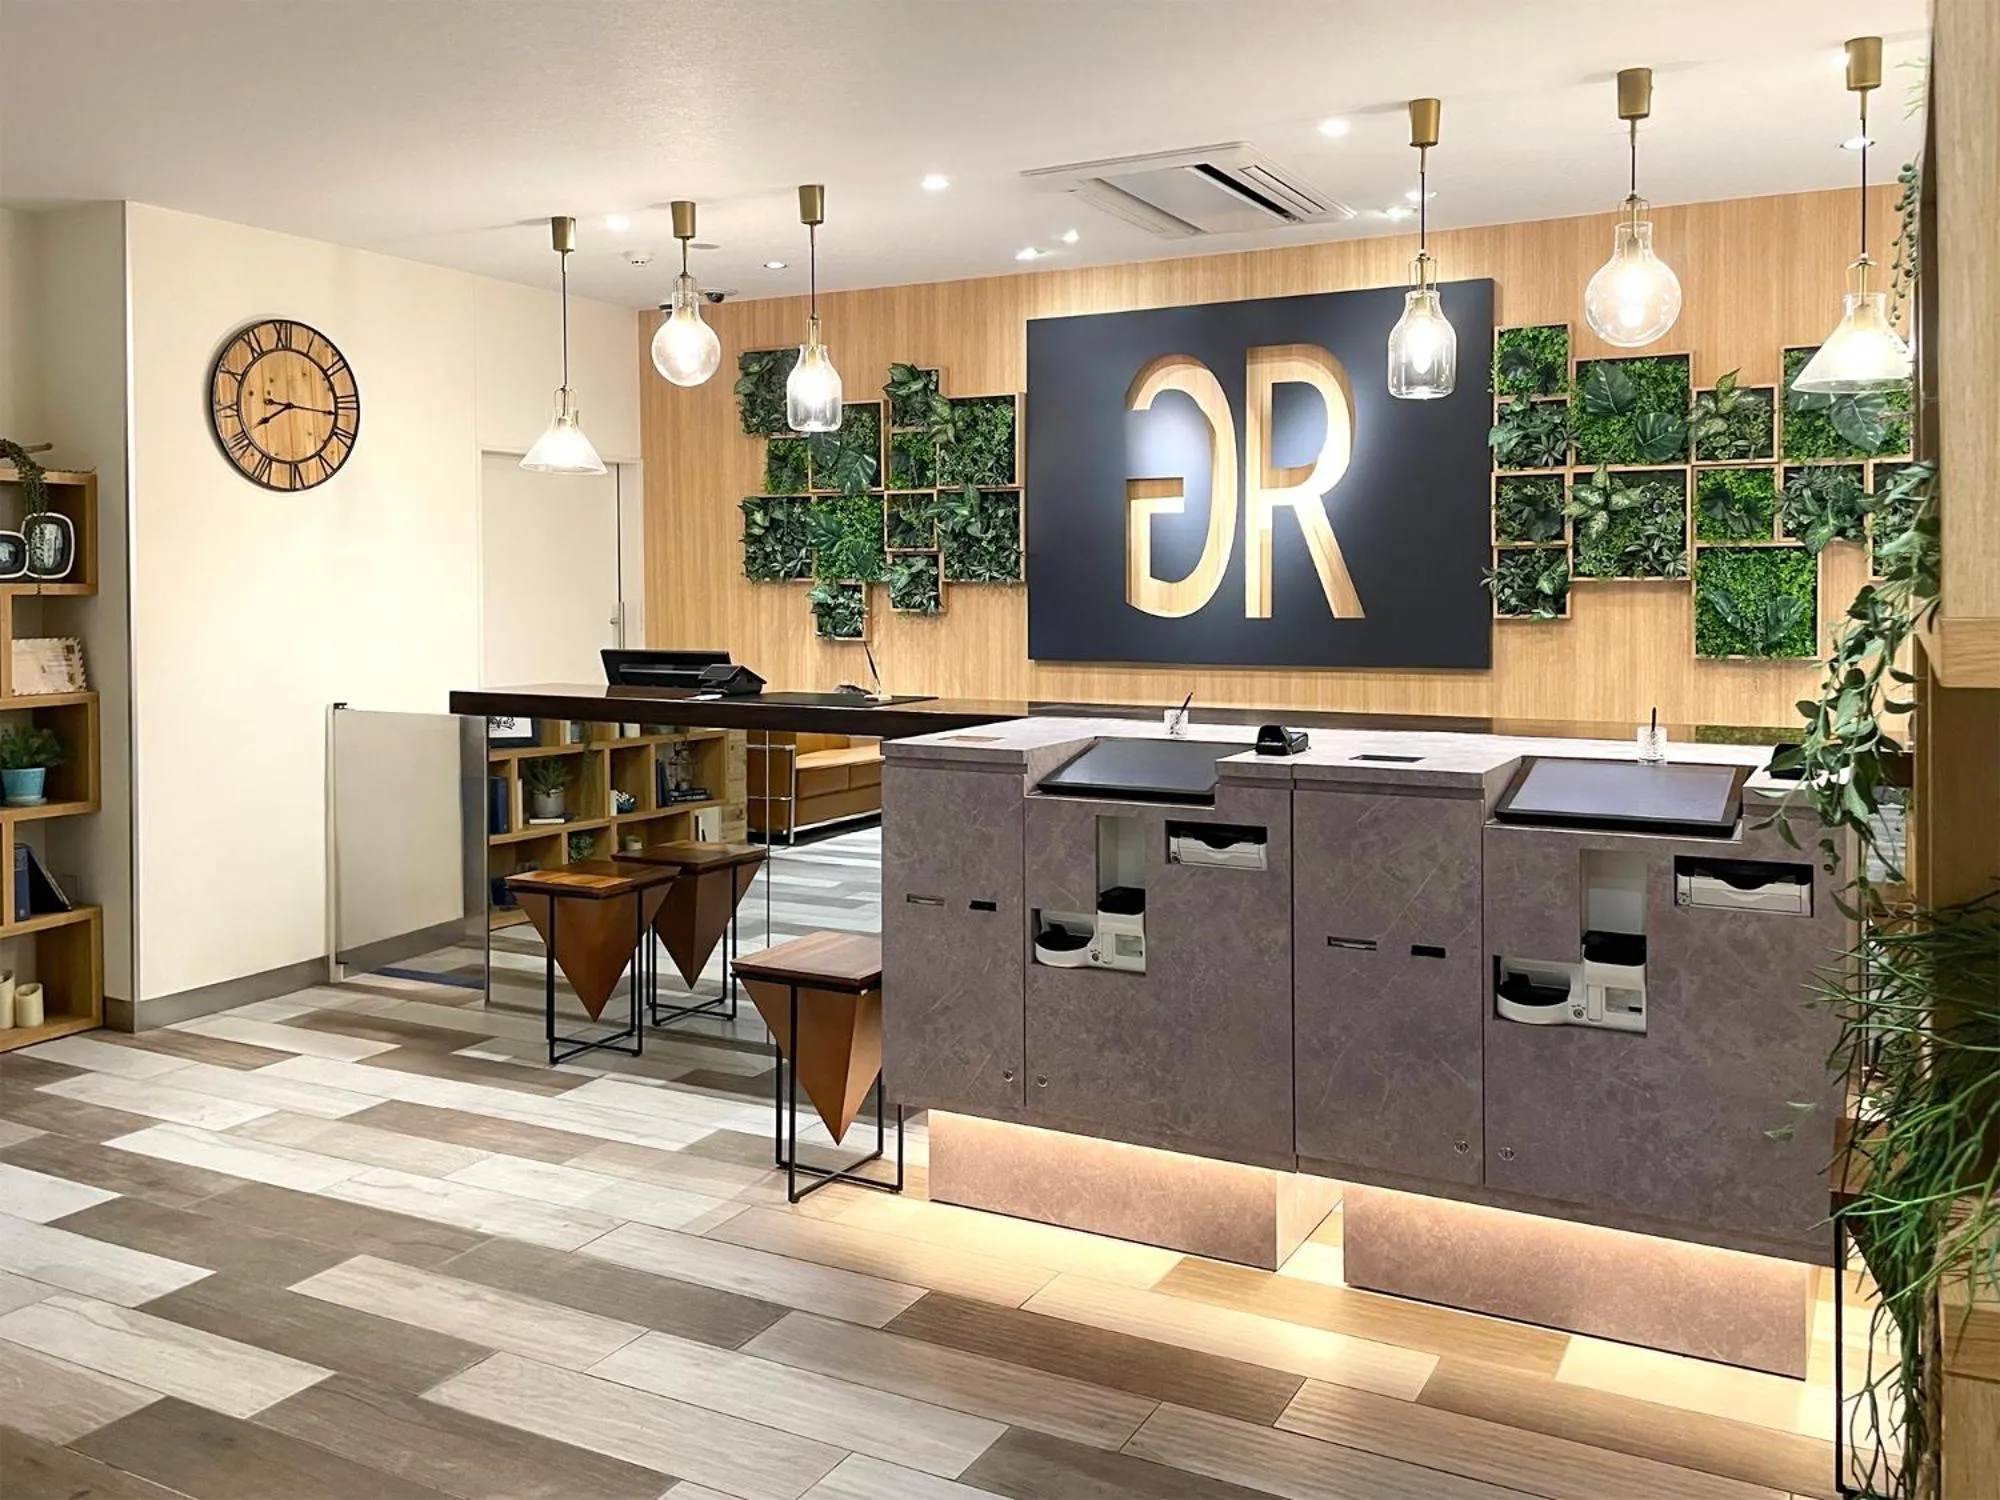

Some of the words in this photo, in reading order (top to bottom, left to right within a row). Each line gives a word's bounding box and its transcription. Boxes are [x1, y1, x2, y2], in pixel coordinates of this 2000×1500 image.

[240, 330, 265, 359] XI
[273, 322, 293, 348] XII
[219, 364, 242, 382] X
[326, 357, 346, 379] II
[337, 394, 358, 409] III
[289, 464, 305, 489] VI
[318, 455, 336, 477] V
